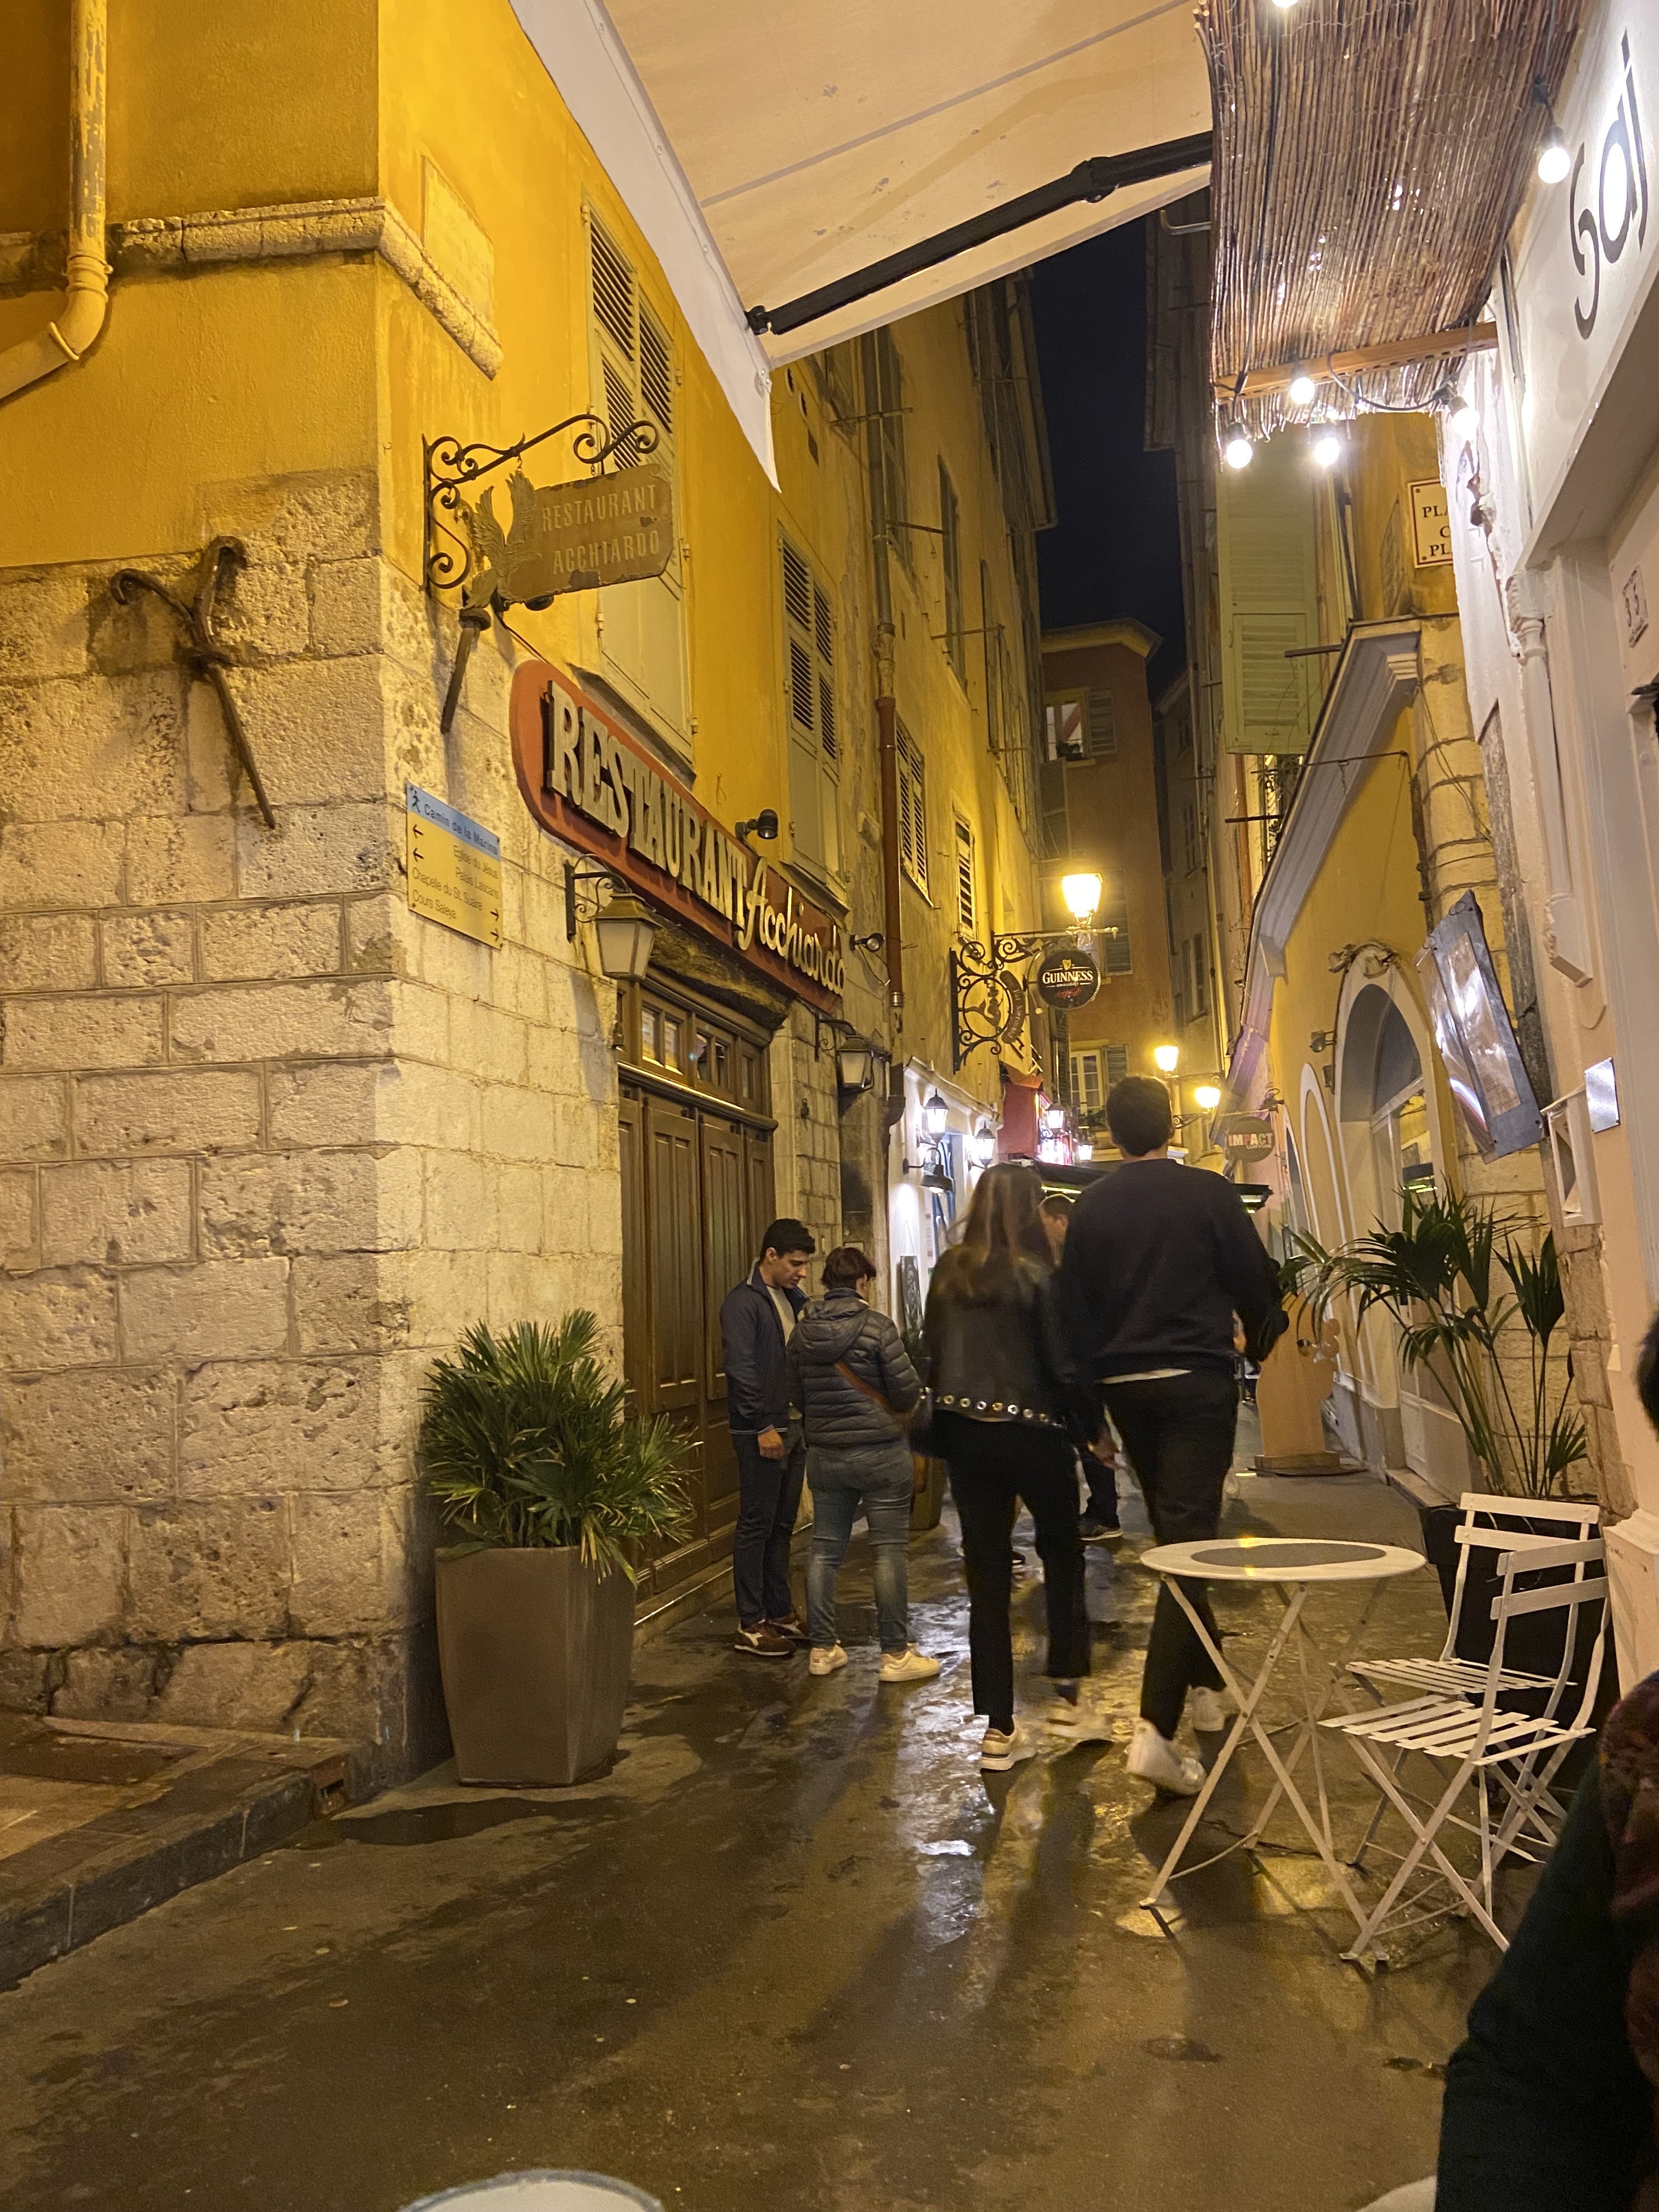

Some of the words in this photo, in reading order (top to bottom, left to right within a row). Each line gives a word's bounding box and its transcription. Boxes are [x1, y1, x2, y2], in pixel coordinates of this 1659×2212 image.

[541, 484, 656, 532] RESTAURANT
[554, 530, 659, 575] ACCHIARDO
[1429, 543, 1453, 557] PL
[424, 803, 450, 827] Camin
[452, 820, 462, 834] de
[464, 826, 471, 840] la
[473, 831, 498, 855] Marina
[548, 680, 748, 931] RESTAURANT
[737, 856, 846, 995] Acchiardo
[472, 857, 481, 870] du
[413, 867, 442, 891] Chapelle
[443, 883, 452, 895] du
[456, 867, 473, 886] Palais
[475, 877, 499, 899] Lascaris
[413, 889, 434, 909] Cours
[435, 899, 456, 919] Saleya
[1042, 970, 1093, 984] GUINNESS
[1228, 1133, 1273, 1146] IMPACT
